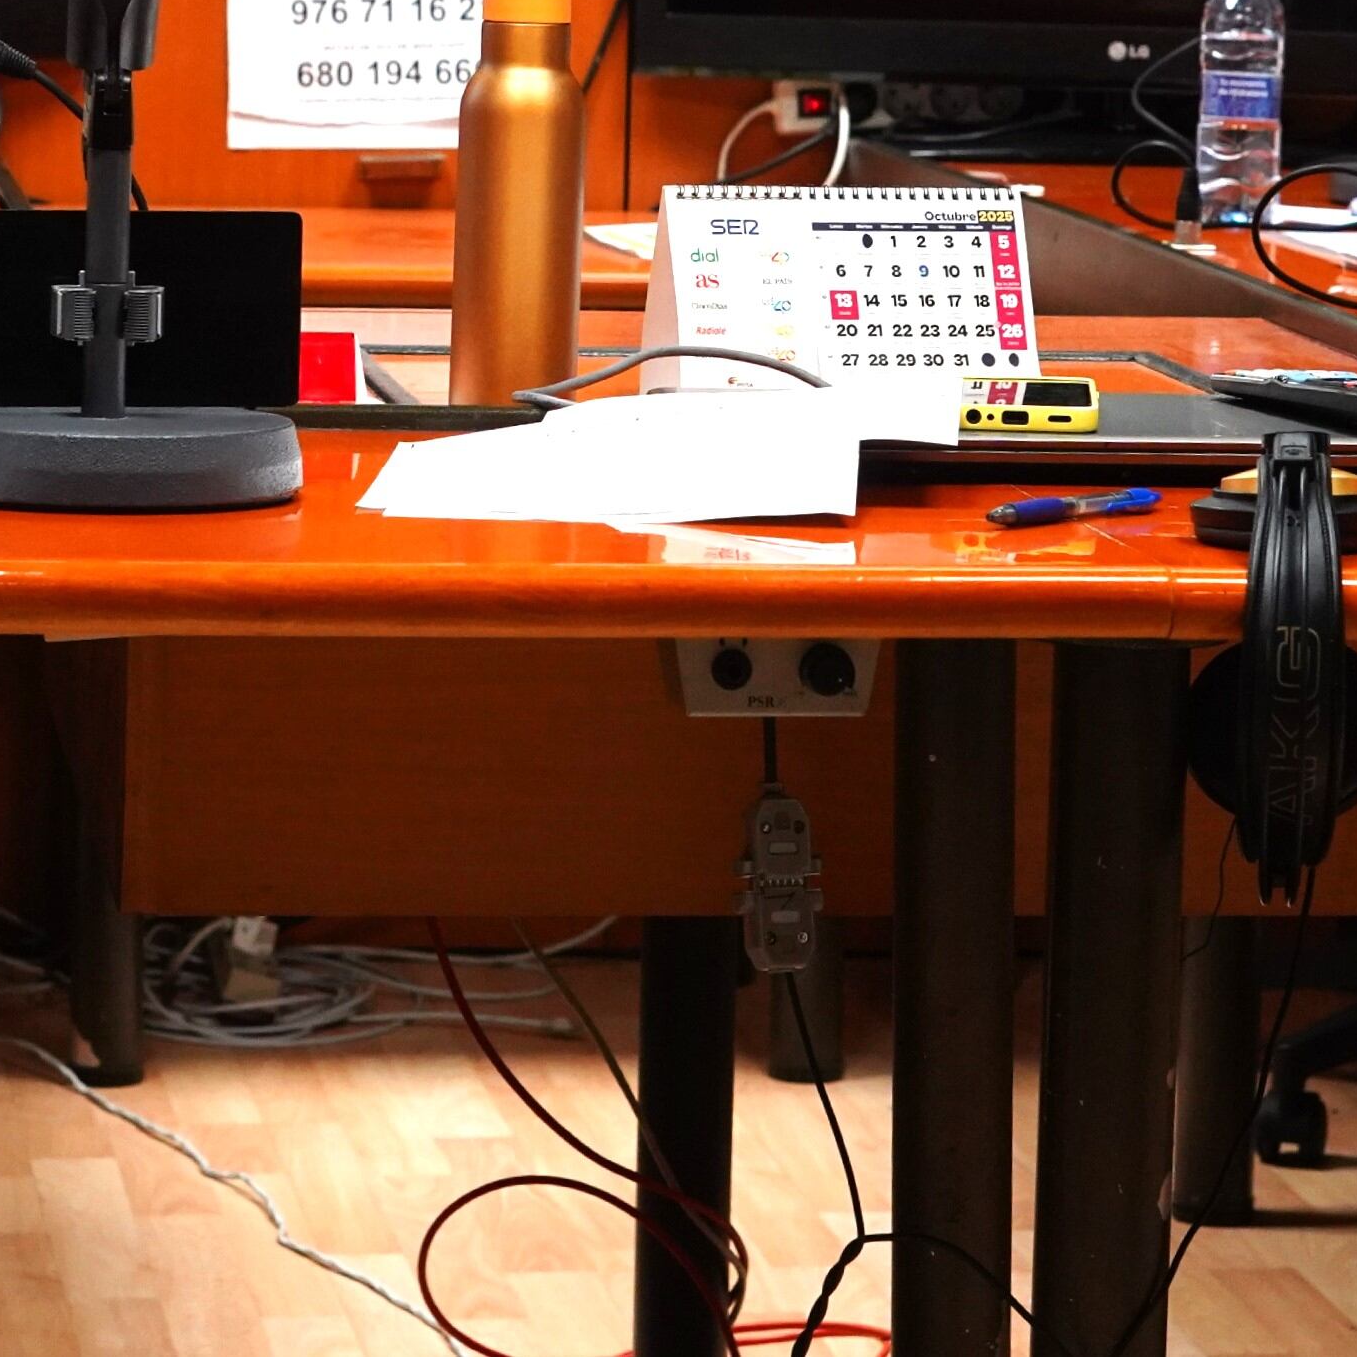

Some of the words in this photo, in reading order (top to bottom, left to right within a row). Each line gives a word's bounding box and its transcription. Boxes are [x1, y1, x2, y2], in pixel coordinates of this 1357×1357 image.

[291, 0, 348, 25] 976
[297, 61, 354, 87] 680
[369, 60, 421, 85] 194
[436, 59, 481, 84] 66
[924, 211, 976, 222] Octubre
[978, 211, 1014, 222] 2025
[710, 219, 760, 235] SER
[890, 235, 897, 248] 1
[916, 235, 927, 248] 2
[944, 235, 954, 248] 3
[971, 236, 982, 248] 4
[997, 235, 1010, 249] 5
[690, 248, 720, 263] dial
[836, 264, 846, 277] 6
[864, 265, 873, 277] 7
[891, 265, 902, 277] 8
[918, 265, 929, 277] 9
[943, 265, 960, 278] 10
[973, 265, 985, 277] 11
[997, 264, 1016, 279] 12
[695, 273, 720, 288] as
[863, 294, 880, 307] 14
[891, 294, 907, 307] 15
[918, 294, 935, 307] 16
[947, 294, 962, 307] 17
[974, 294, 990, 308] 18
[836, 324, 858, 337] 20
[867, 324, 883, 337] 21
[892, 324, 913, 337] 22
[920, 324, 940, 337] 23
[947, 324, 968, 337] 24
[975, 324, 996, 337] 25
[1000, 323, 1023, 339] 26
[841, 353, 859, 367] 27
[868, 353, 889, 367] 28
[896, 353, 916, 367] 29
[923, 353, 944, 367] 30
[953, 353, 970, 367] 31
[747, 695, 775, 708] PSR
[1267, 625, 1322, 827] AKG
